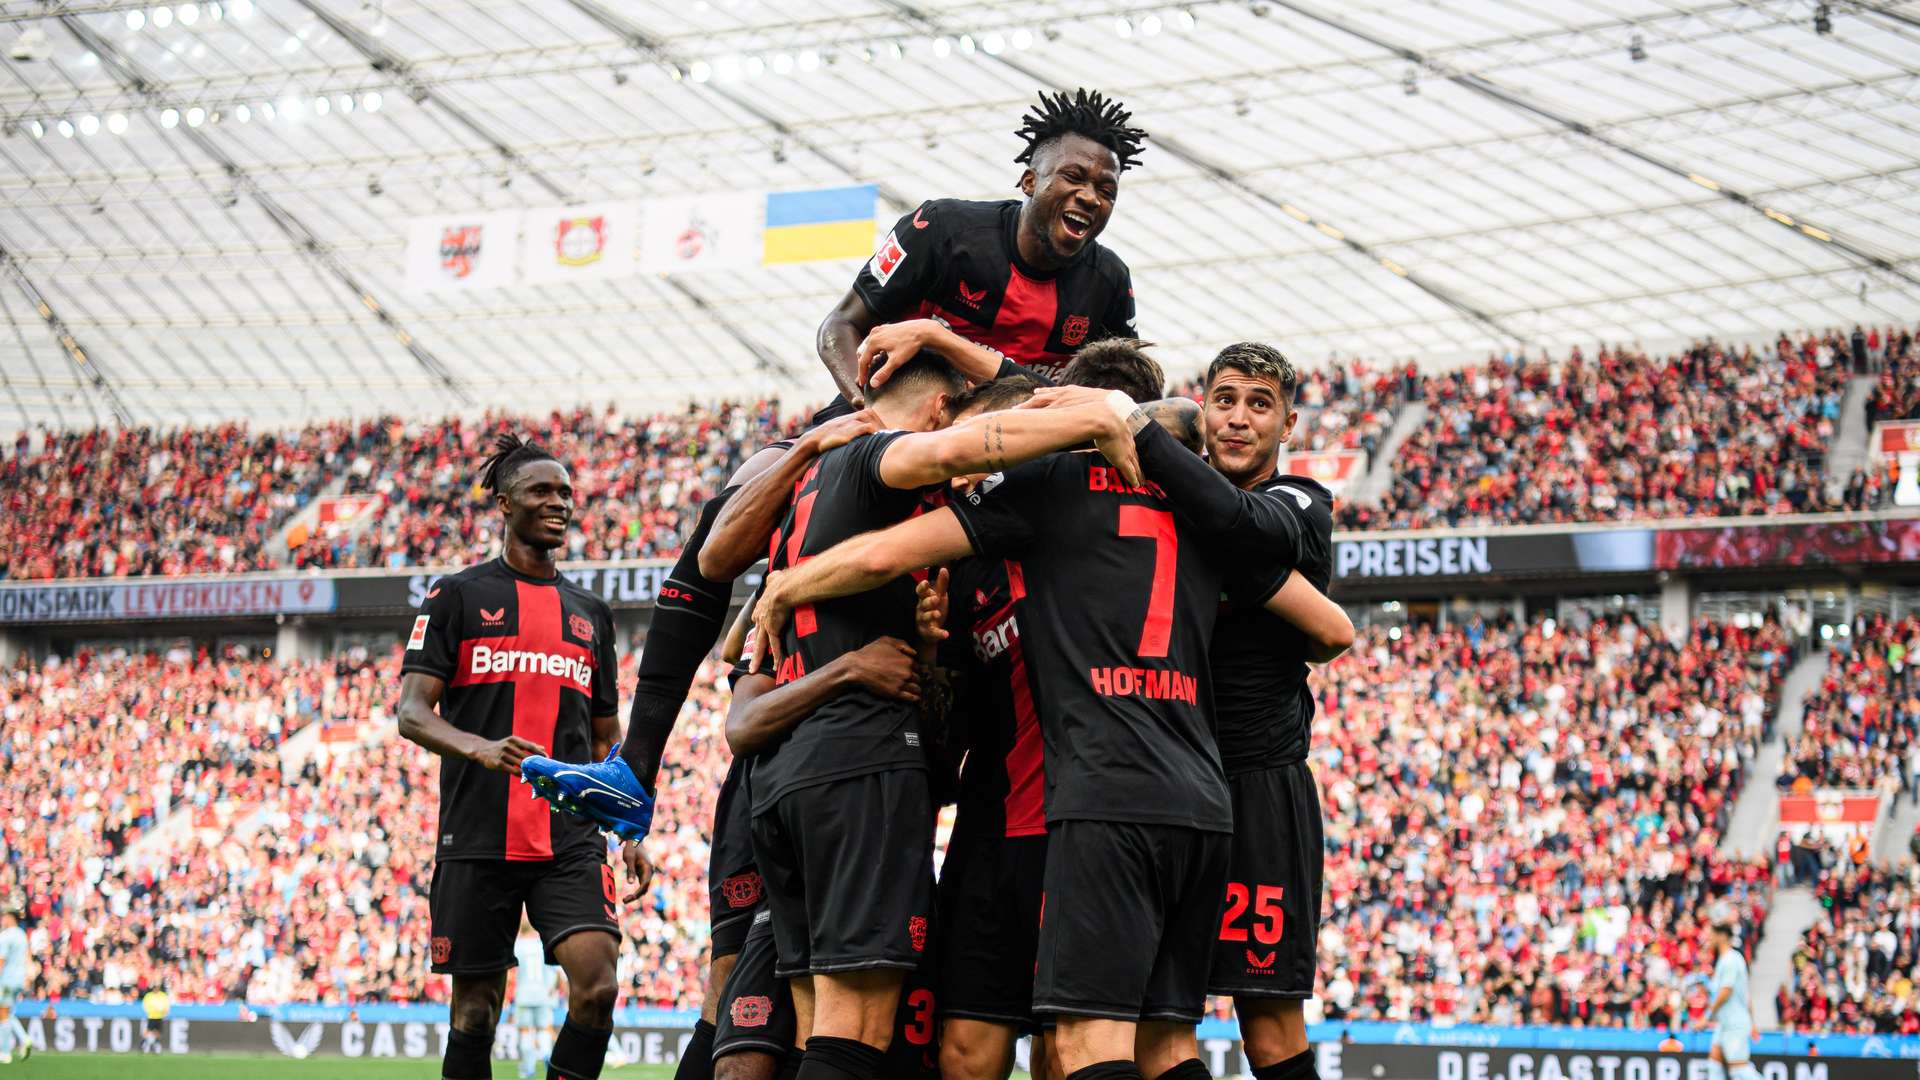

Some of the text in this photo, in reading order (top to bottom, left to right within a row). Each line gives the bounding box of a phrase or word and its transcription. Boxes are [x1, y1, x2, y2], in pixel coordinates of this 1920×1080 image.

[123, 582, 282, 616] LEVERKUSEN
[1119, 504, 1177, 657] 7
[471, 645, 592, 687] Barmenia
[1219, 882, 1284, 945] 25
[2, 1016, 190, 1053] ASTOE
[905, 989, 935, 1045] 3
